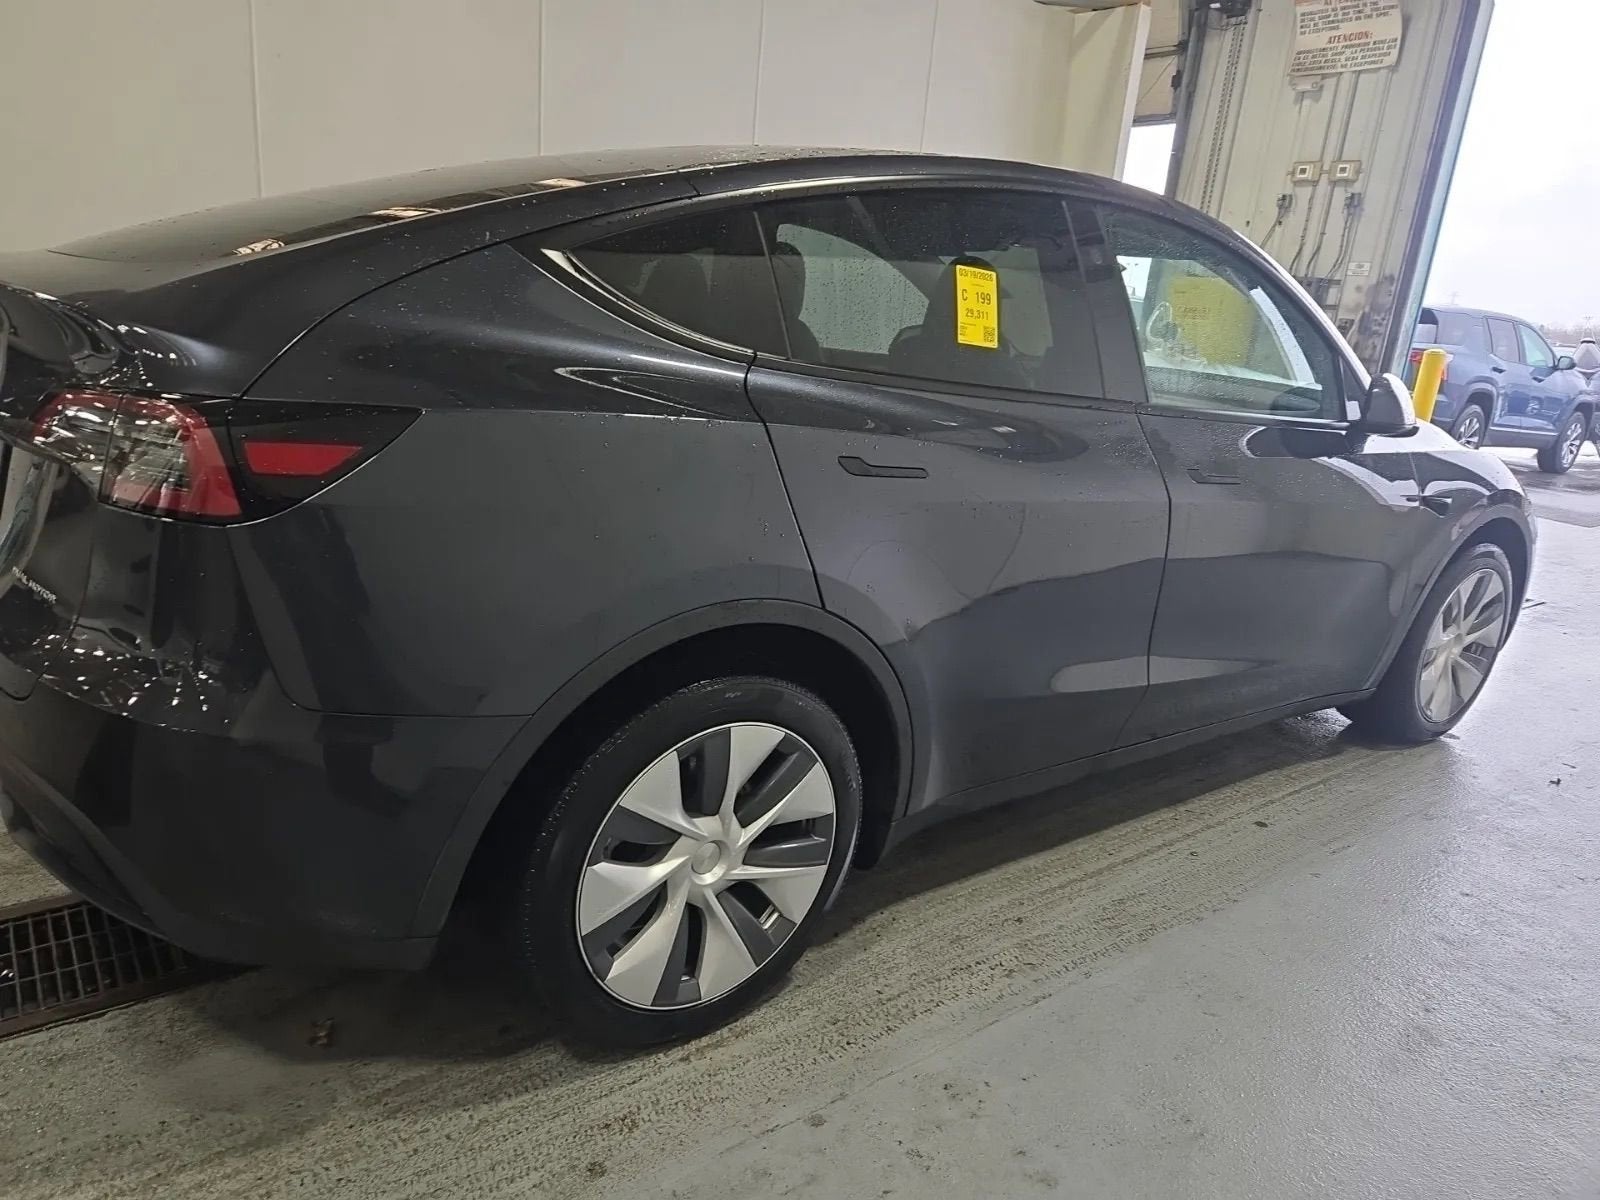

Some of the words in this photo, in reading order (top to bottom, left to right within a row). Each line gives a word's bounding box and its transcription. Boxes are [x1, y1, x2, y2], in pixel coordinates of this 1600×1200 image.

[1326, 31, 1373, 45] ATENCION:
[961, 289, 968, 301] C
[975, 291, 991, 305] 199
[965, 308, 989, 321] 29,311
[28, 580, 56, 604] MOTOR
